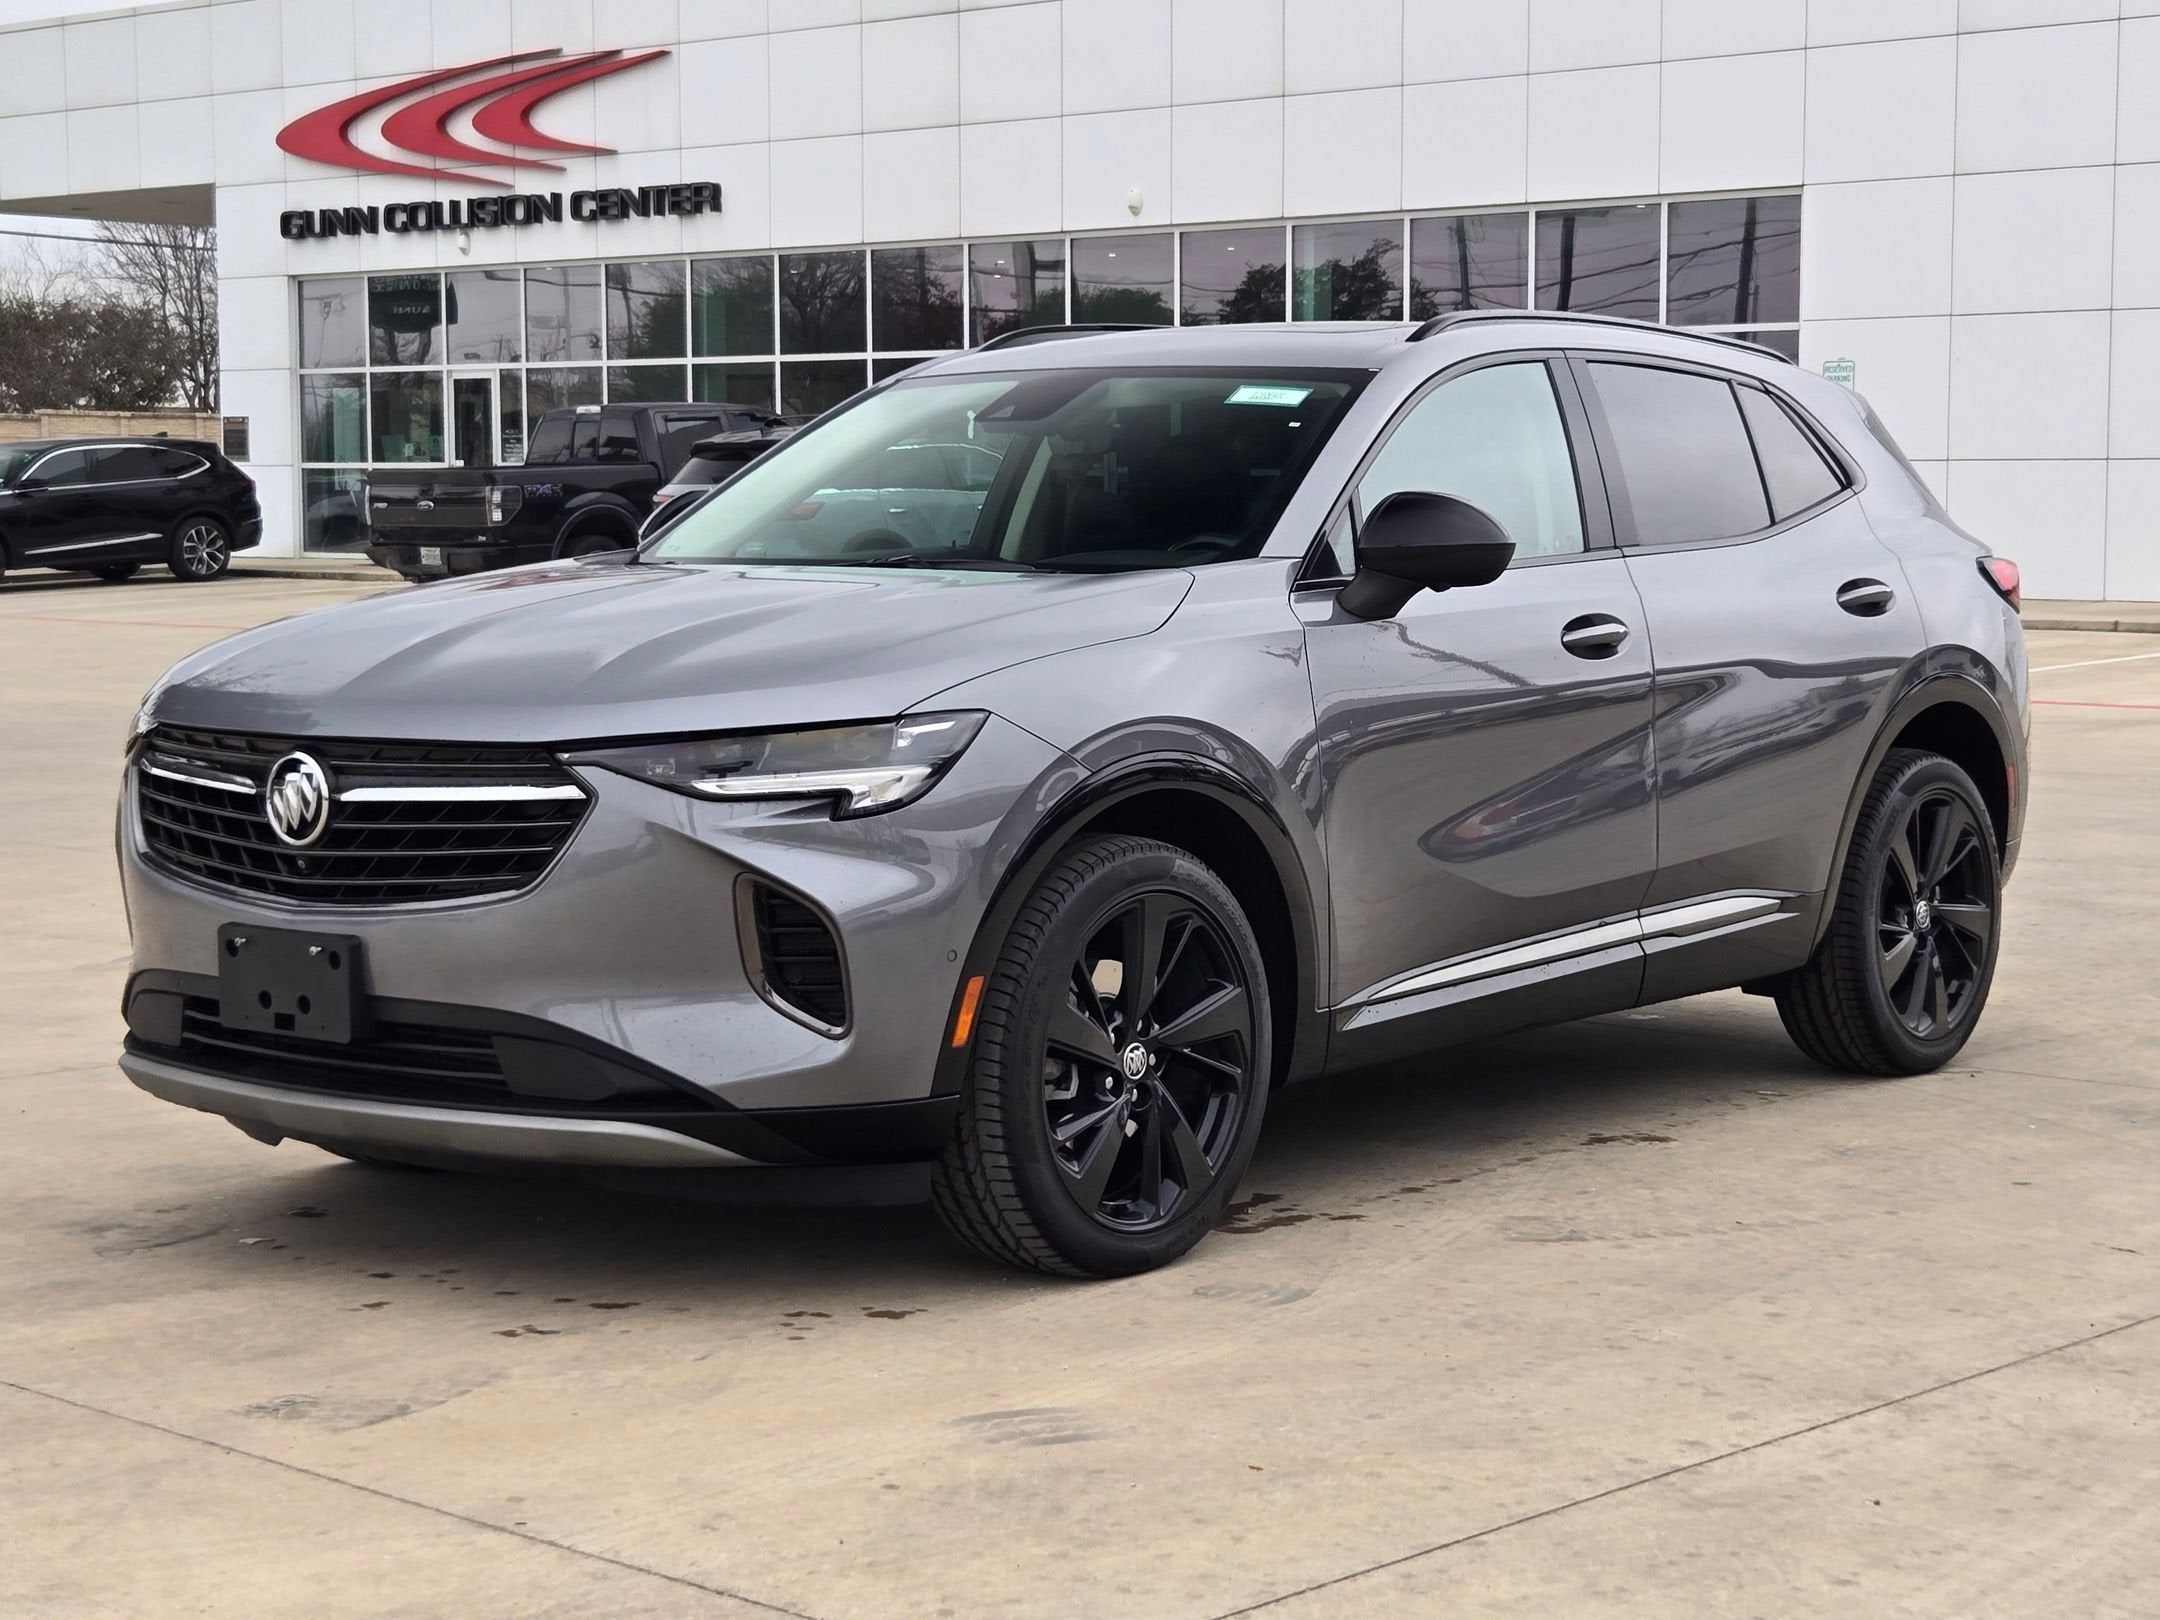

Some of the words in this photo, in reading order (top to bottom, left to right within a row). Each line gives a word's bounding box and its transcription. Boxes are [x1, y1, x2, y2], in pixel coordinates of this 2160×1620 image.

[280, 206, 378, 240] GUNN
[383, 192, 562, 232] COLLISION
[570, 181, 722, 222] CENTER
